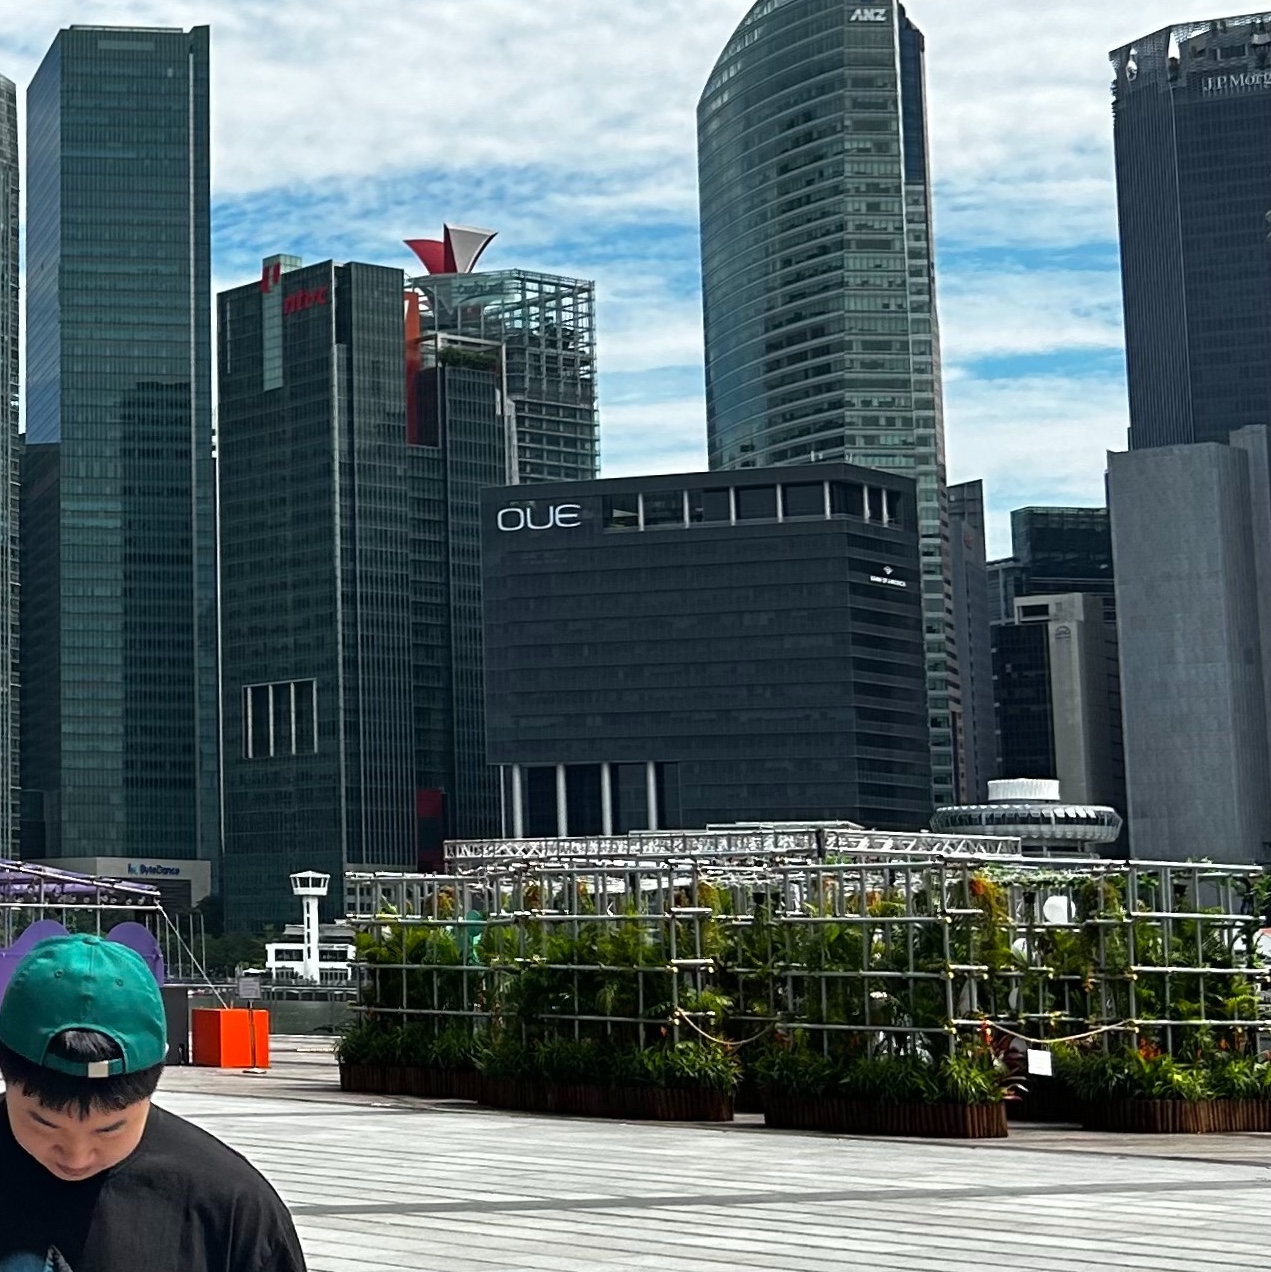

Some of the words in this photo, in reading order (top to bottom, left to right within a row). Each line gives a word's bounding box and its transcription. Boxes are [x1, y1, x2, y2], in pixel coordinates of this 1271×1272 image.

[849, 8, 887, 21] ANZ
[497, 503, 582, 531] OUE
[139, 864, 181, 876] ByteDance
